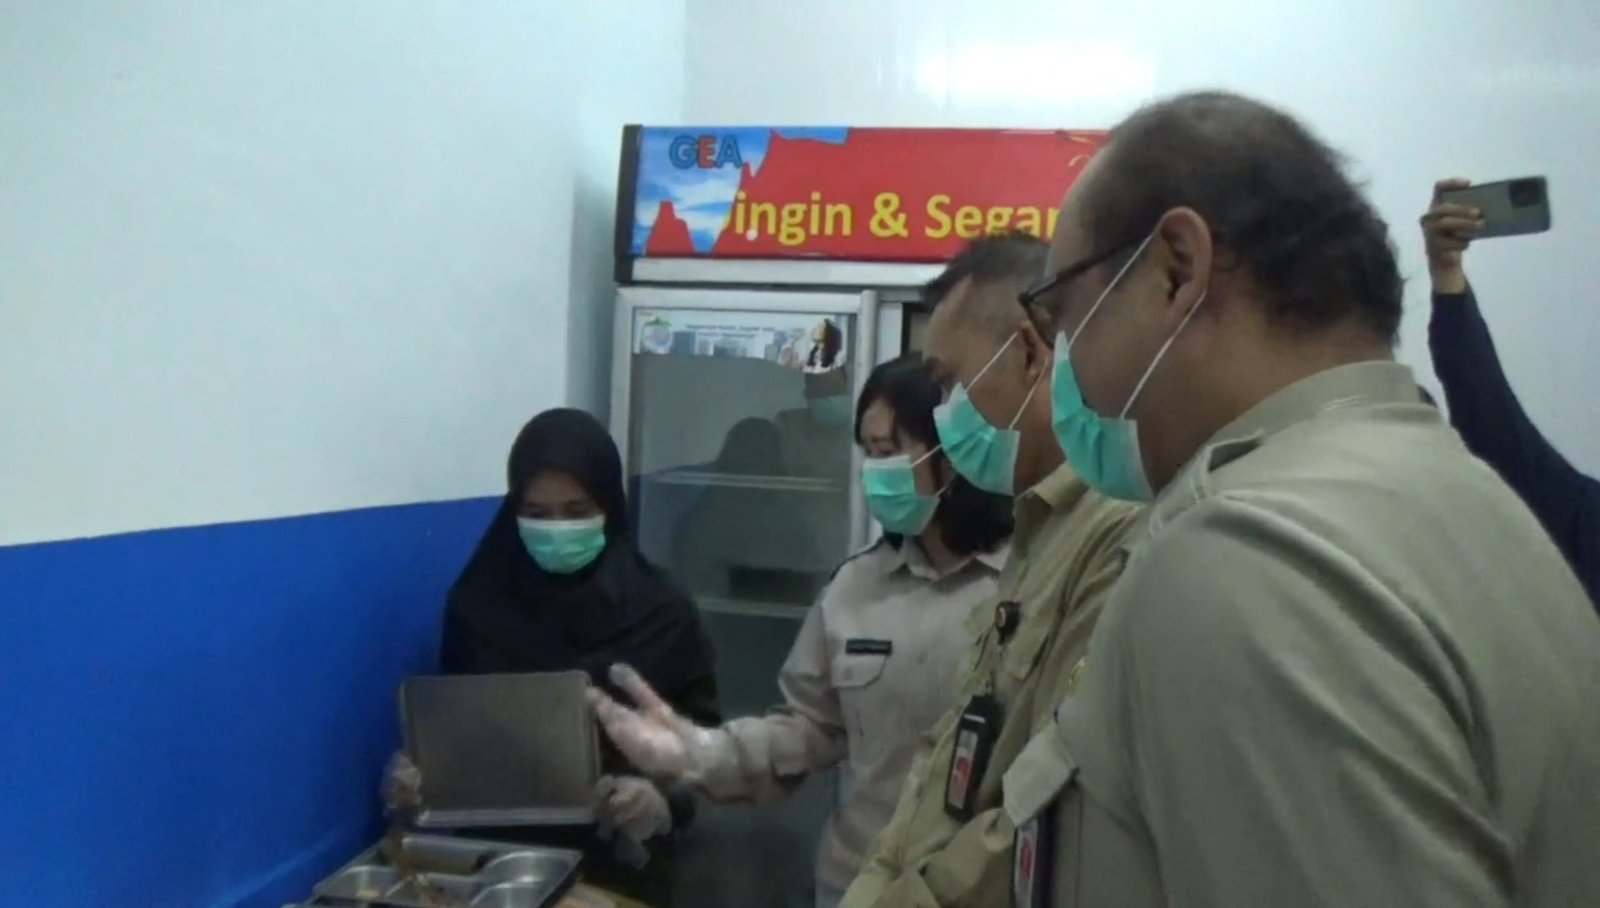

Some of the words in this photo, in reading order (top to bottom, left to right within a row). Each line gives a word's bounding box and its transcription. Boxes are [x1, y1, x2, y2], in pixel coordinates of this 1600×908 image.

[668, 133, 743, 170] GEA
[721, 190, 852, 246] ingin
[869, 191, 909, 238] &
